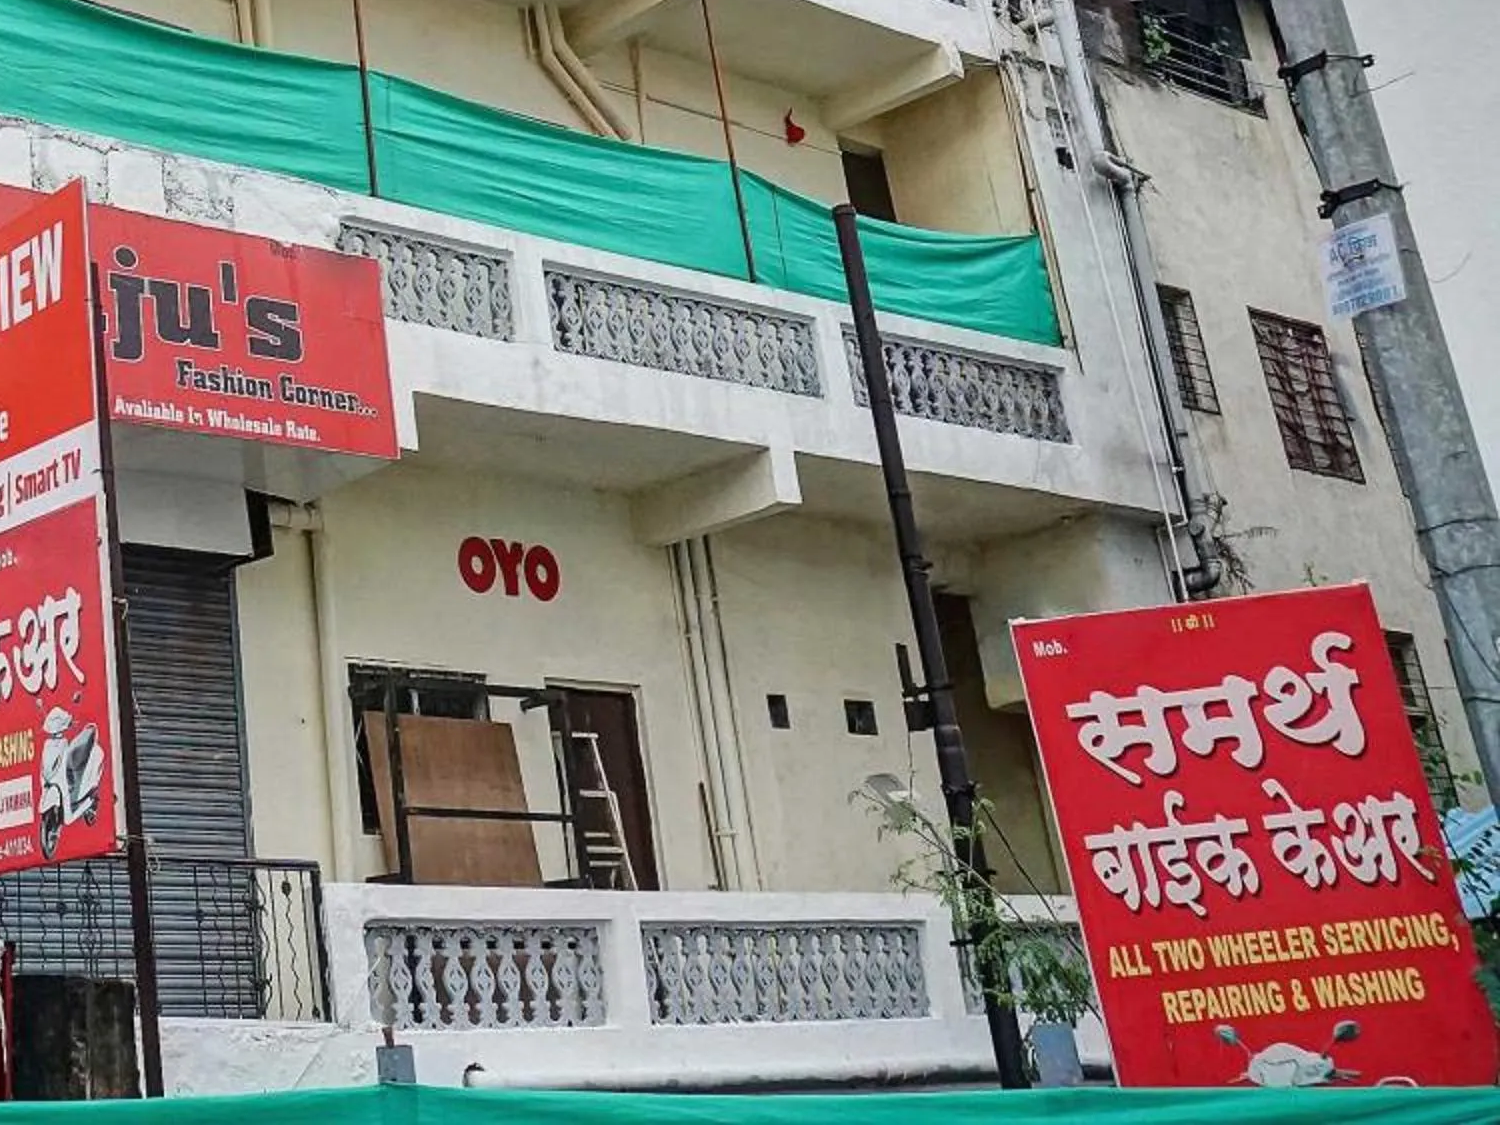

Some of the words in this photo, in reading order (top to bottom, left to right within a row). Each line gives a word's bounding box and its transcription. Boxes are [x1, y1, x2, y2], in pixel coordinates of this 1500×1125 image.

[175, 357, 274, 401] Fashion
[15, 458, 60, 505] Smart
[61, 448, 82, 483] TV
[457, 535, 561, 602] OYO
[1033, 639, 1068, 658] Mob.
[1065, 631, 1366, 786] समर्थ
[1084, 789, 1260, 917] बाईक
[1108, 944, 1152, 978] ALL
[1152, 936, 1205, 973] TWO
[1208, 924, 1320, 967] WHEELER
[1322, 911, 1460, 956] SERVICING,
[1161, 981, 1287, 1024] REPAIRING
[1290, 978, 1312, 1011] &
[1312, 966, 1426, 1009] WASHING
